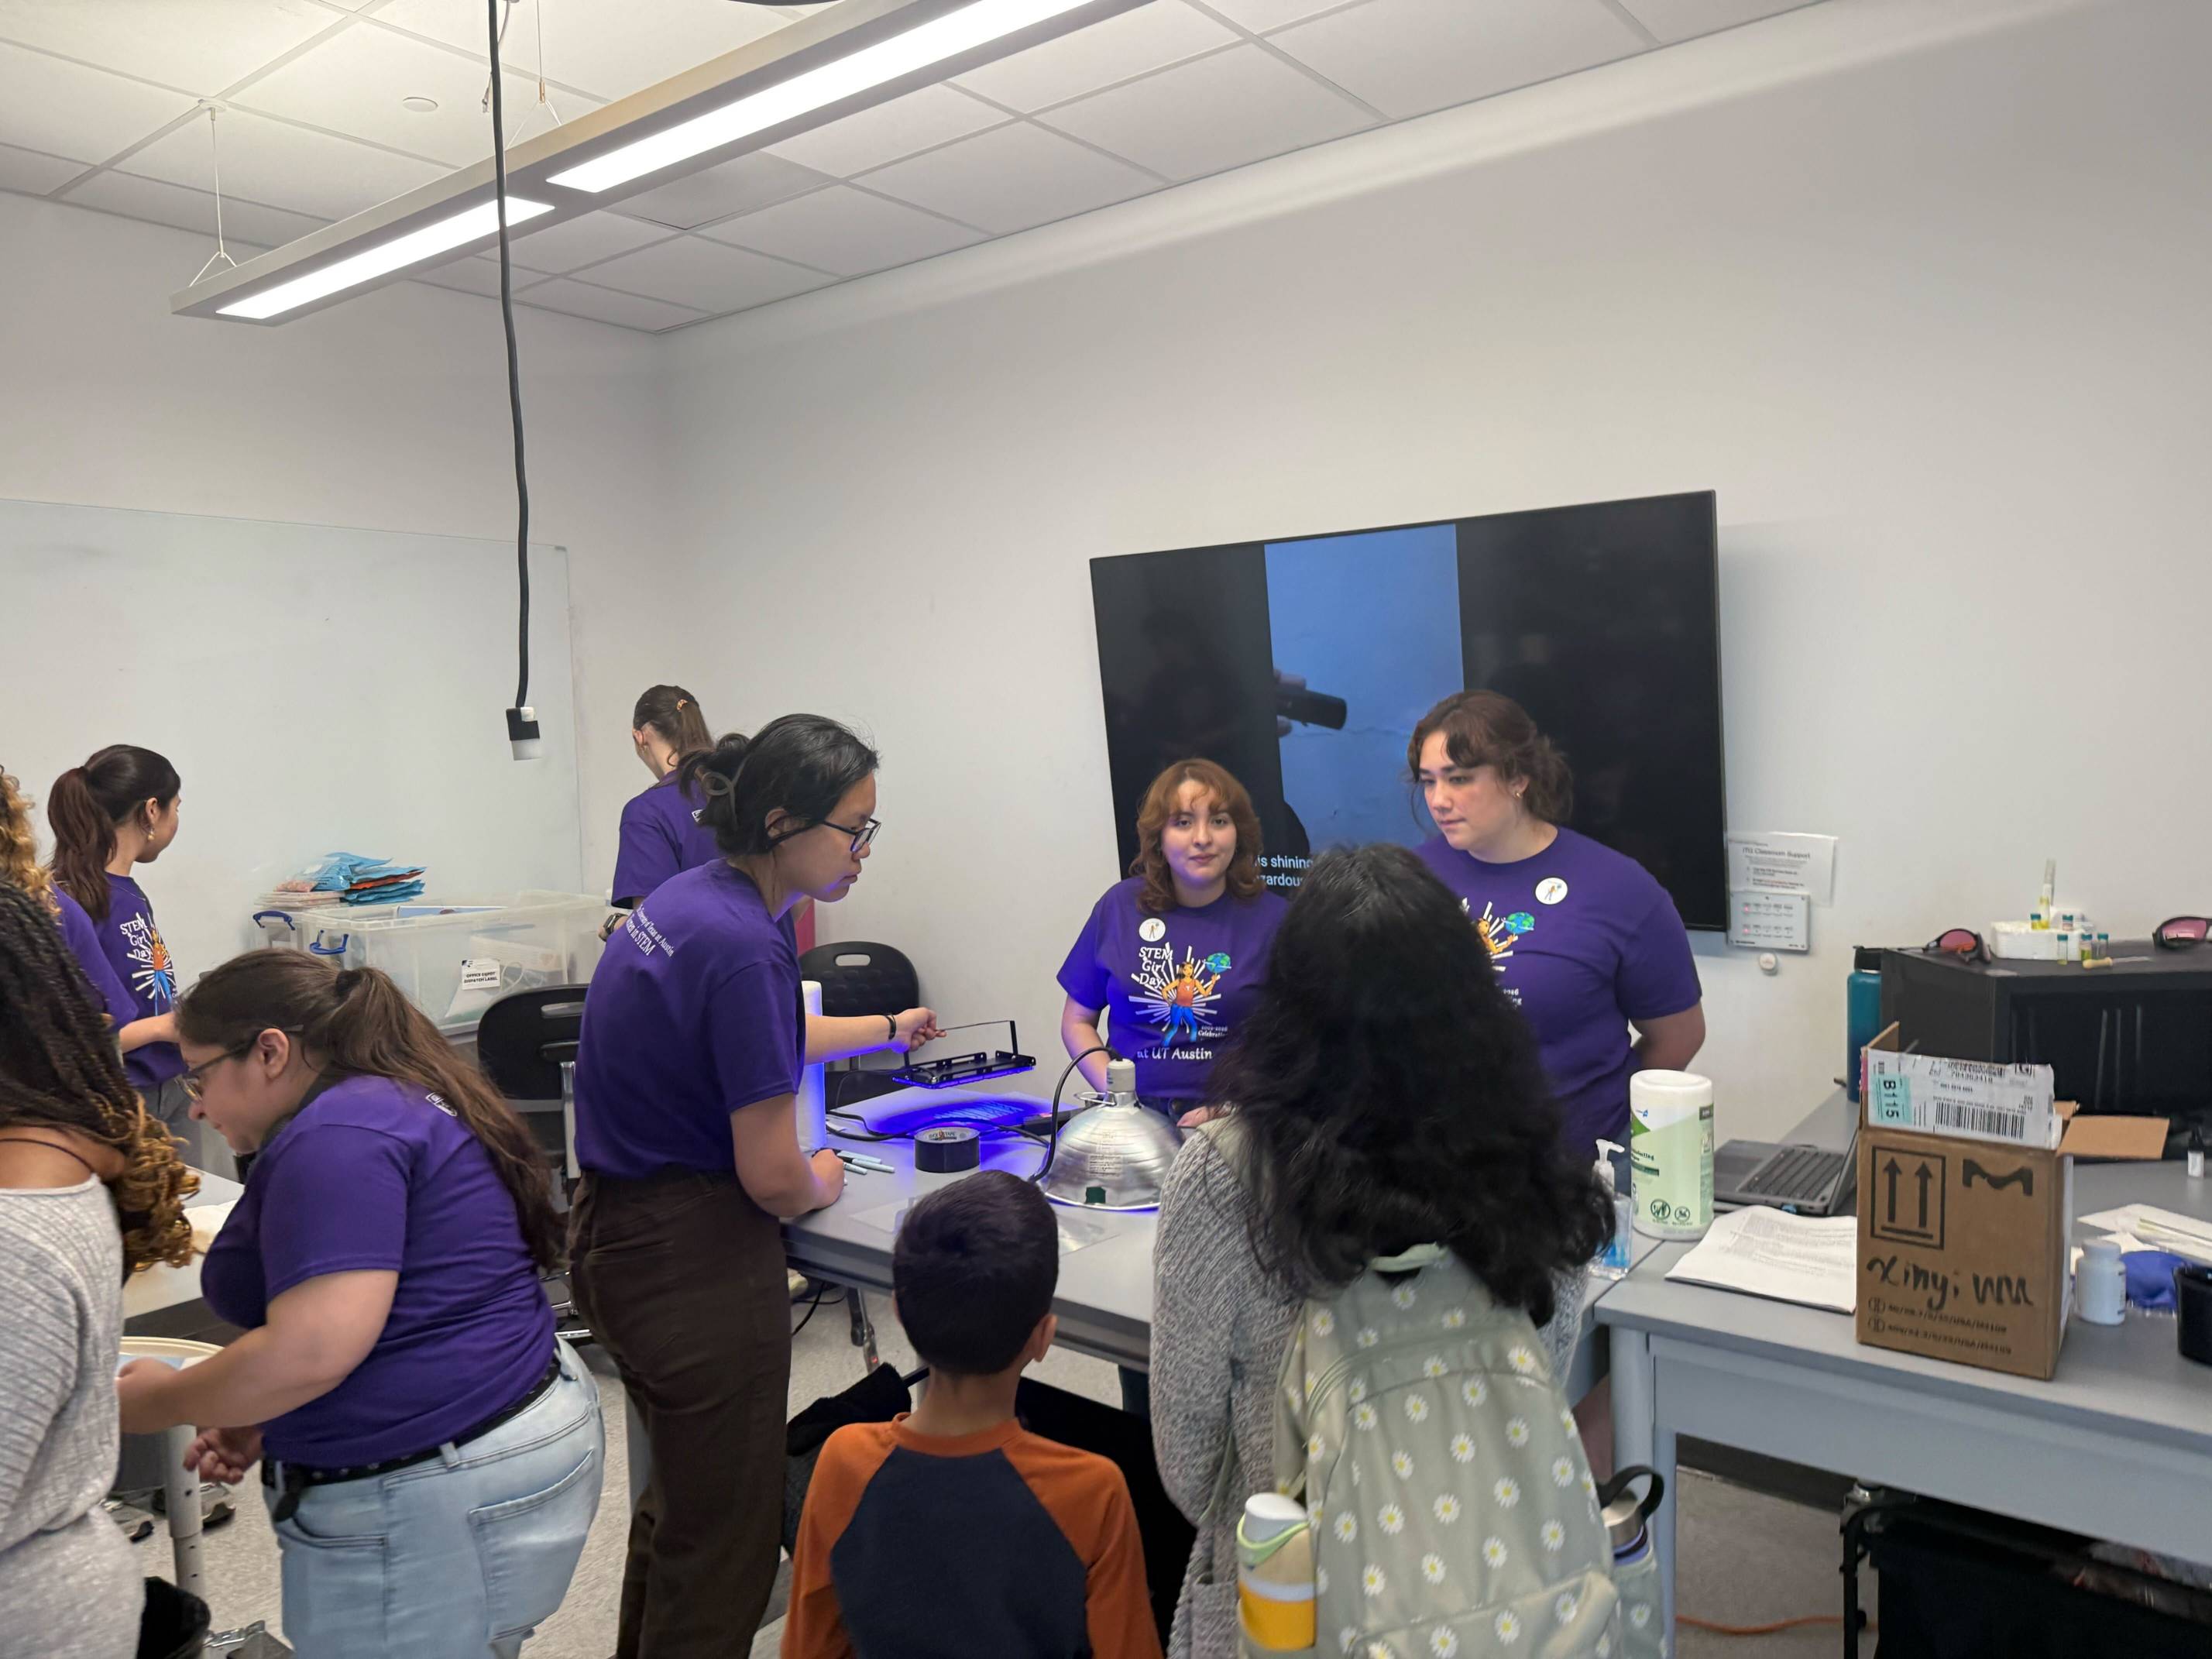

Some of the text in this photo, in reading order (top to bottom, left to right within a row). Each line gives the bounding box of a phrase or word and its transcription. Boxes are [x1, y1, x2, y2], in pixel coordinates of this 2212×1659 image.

[119, 919, 147, 935] STEM
[129, 930, 149, 946] Girl
[634, 931, 656, 956] STEM
[133, 948, 152, 960] Day
[658, 938, 674, 957] Austin
[1139, 946, 1173, 960] STEM
[1142, 960, 1166, 972] Girl
[1139, 973, 1163, 989] Day
[1152, 1048, 1170, 1060] UT
[1171, 1047, 1212, 1060] Austin
[1883, 1079, 1899, 1118] B115
